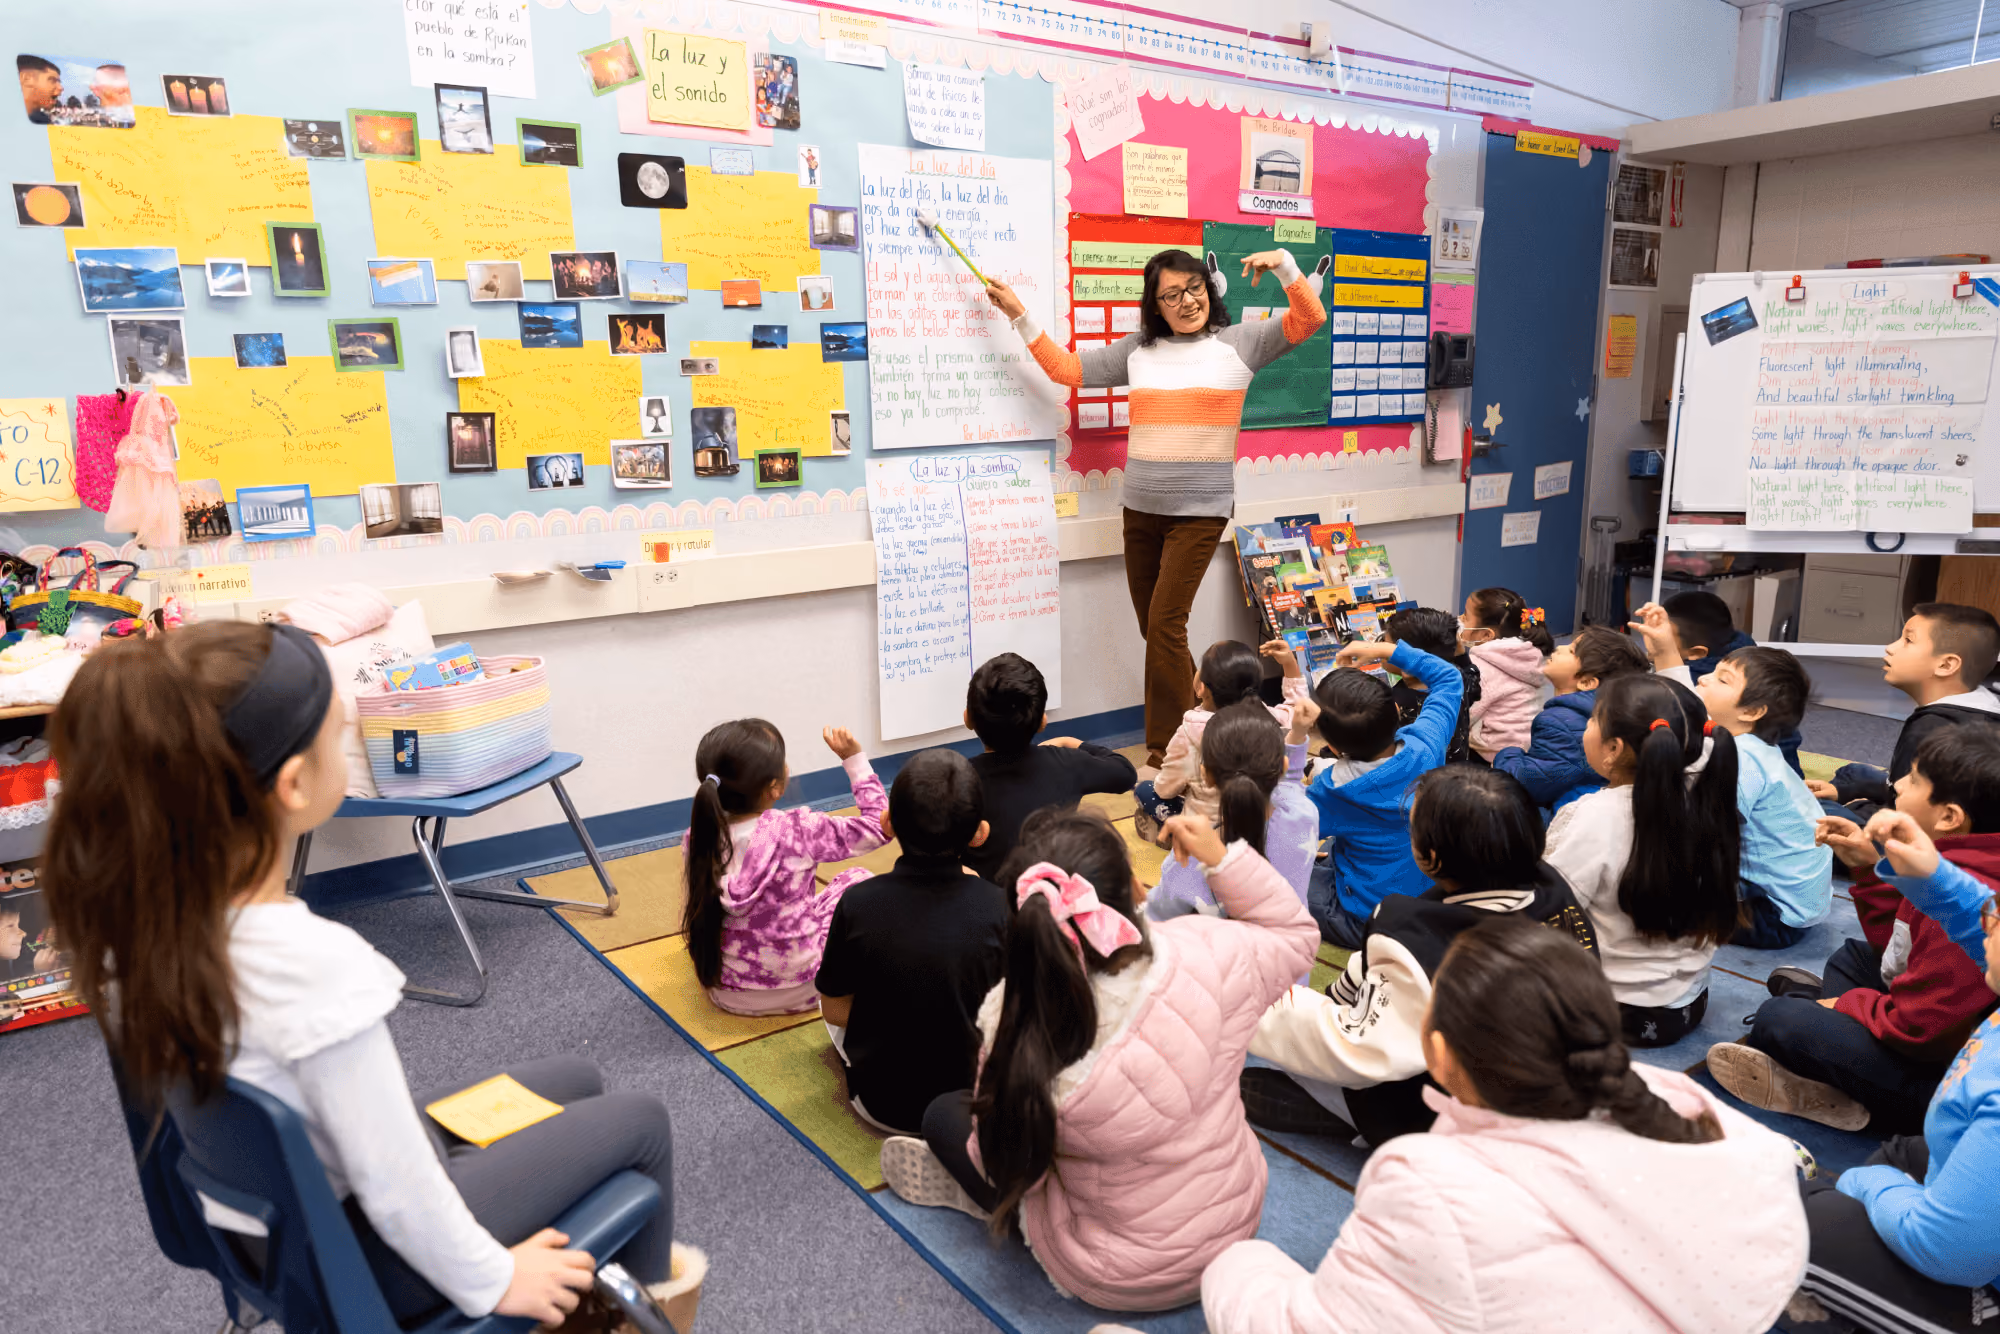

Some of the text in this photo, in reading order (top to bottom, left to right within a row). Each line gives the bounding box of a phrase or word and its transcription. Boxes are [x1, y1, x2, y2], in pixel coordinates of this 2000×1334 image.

[444, 0, 520, 22] qué está el
[997, 10, 1050, 28] 72 73 75
[414, 20, 454, 36] pueblo
[464, 24, 478, 39] de
[838, 29, 869, 41] duraderos
[417, 42, 516, 70] en la sombra?
[652, 33, 728, 74] La luz y
[652, 72, 727, 104] el sonido
[926, 86, 968, 103] de físicos
[1100, 90, 1114, 105] son
[1116, 78, 1129, 96] los
[1254, 118, 1298, 137] The Bridge
[910, 151, 996, 177] La luz del día
[1172, 153, 1183, 164] que
[862, 174, 1009, 206] La luz del día, la luz del día
[864, 202, 883, 217] nos
[888, 199, 900, 218] da
[946, 206, 989, 230] energía,
[1252, 196, 1299, 213] Cognados
[864, 216, 1018, 242] el haz de recto
[1278, 224, 1312, 241] Cognates
[866, 240, 943, 266] y siempre viaja
[867, 262, 922, 291] El sol y el
[868, 287, 906, 302] forman
[914, 290, 926, 302] un
[932, 286, 967, 302] colorido
[1074, 280, 1133, 297] Algo diferente es
[1852, 282, 1889, 304] Light
[868, 304, 984, 330] En las gotitas que caen
[1764, 300, 1806, 319] Natural
[1815, 301, 1839, 322] light
[1882, 298, 1924, 316] artificial
[1928, 297, 1954, 316] light
[1960, 296, 1991, 318] there,
[870, 320, 992, 338] vemos los bellos colores.
[1764, 316, 1983, 338] Light waves, light waves everywhere.
[886, 351, 1021, 369] usas prisma con una
[1759, 354, 1928, 377] Fluorescent light illuminating,
[872, 364, 1014, 386] también forma un arcoiris.
[887, 382, 1026, 408] no hay luz no hay colores
[1756, 386, 1955, 406] And beautiful starlight twinkling
[874, 399, 986, 427] eso ya lo comprobé.
[962, 420, 1032, 442] Por Lupita Gallardo
[1752, 426, 1977, 447] Some light through the translucent sheers,
[15, 457, 62, 486] C-12
[916, 458, 930, 478] La
[934, 456, 950, 477] luz
[954, 466, 961, 480] y
[980, 456, 1014, 475] sombra
[1749, 456, 1942, 477] No light through the opaque door.
[876, 479, 930, 501] Yo sé que
[966, 472, 1032, 492] Quiero saber
[684, 538, 712, 550] rotular
[199, 577, 246, 592] narrativo
[920, 602, 946, 616] brillante
